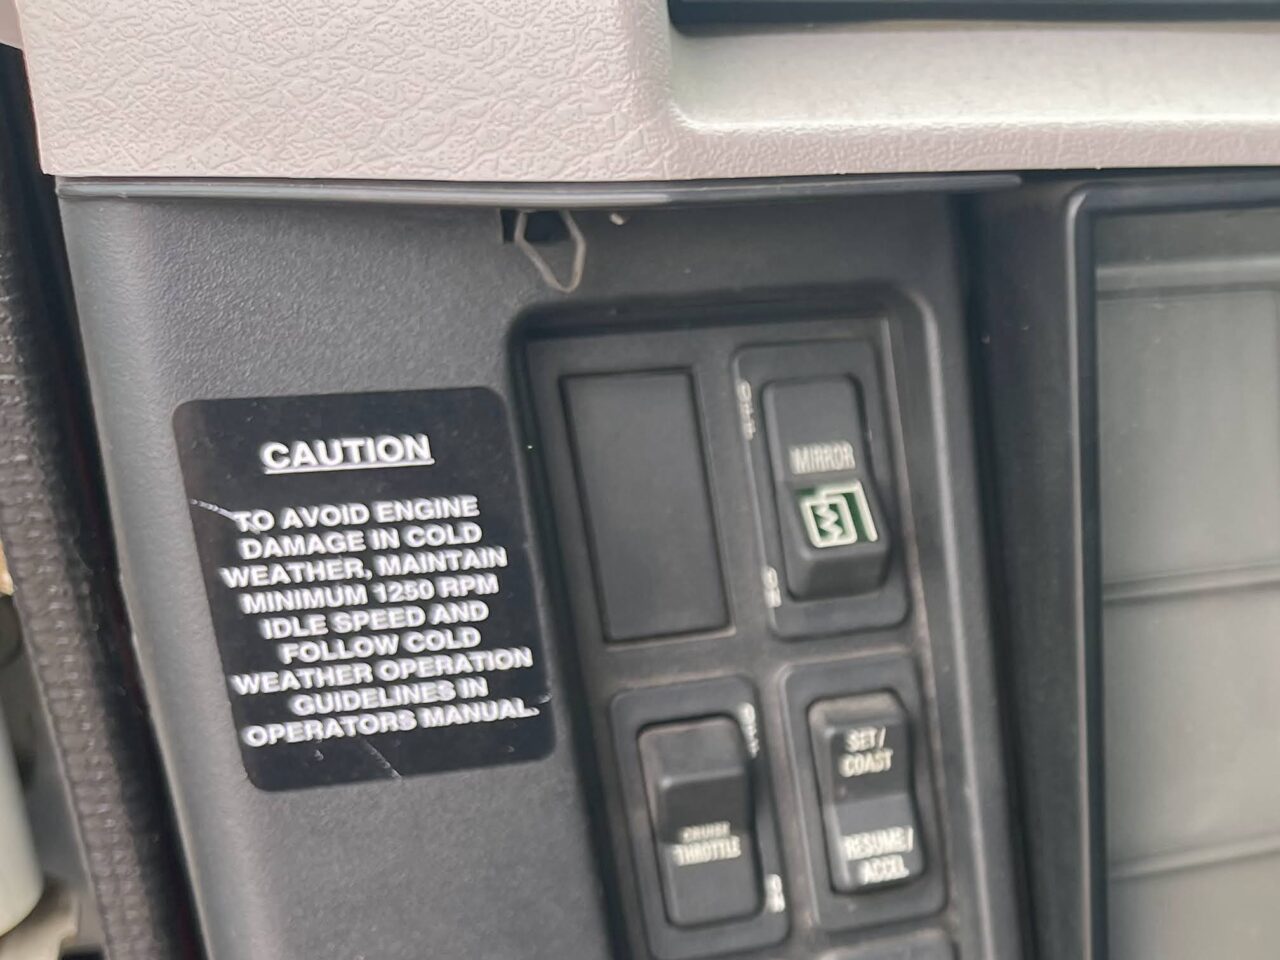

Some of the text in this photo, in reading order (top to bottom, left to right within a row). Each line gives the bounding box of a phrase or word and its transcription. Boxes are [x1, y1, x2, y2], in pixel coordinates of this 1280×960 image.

[260, 433, 434, 472] CAUTION
[789, 441, 856, 475] MIRROR
[234, 495, 479, 533] TO AVOID ENGINE
[238, 521, 482, 560] DAMAGE IN COLD
[219, 546, 507, 588] WEATHER, MAINTAIN
[239, 573, 499, 614] MINIMUM 1250 RPM
[762, 566, 782, 608] ON
[260, 600, 489, 640] IDLE SPEED AND
[278, 627, 482, 665] FOLLOW COLD
[231, 647, 534, 696] WEATHER OPERATION
[289, 675, 488, 716] GUIDELINES IN
[242, 710, 418, 747] OPERATORS
[838, 749, 894, 778] COAST
[672, 836, 742, 867] THROTTLE
[766, 873, 786, 913] ON
